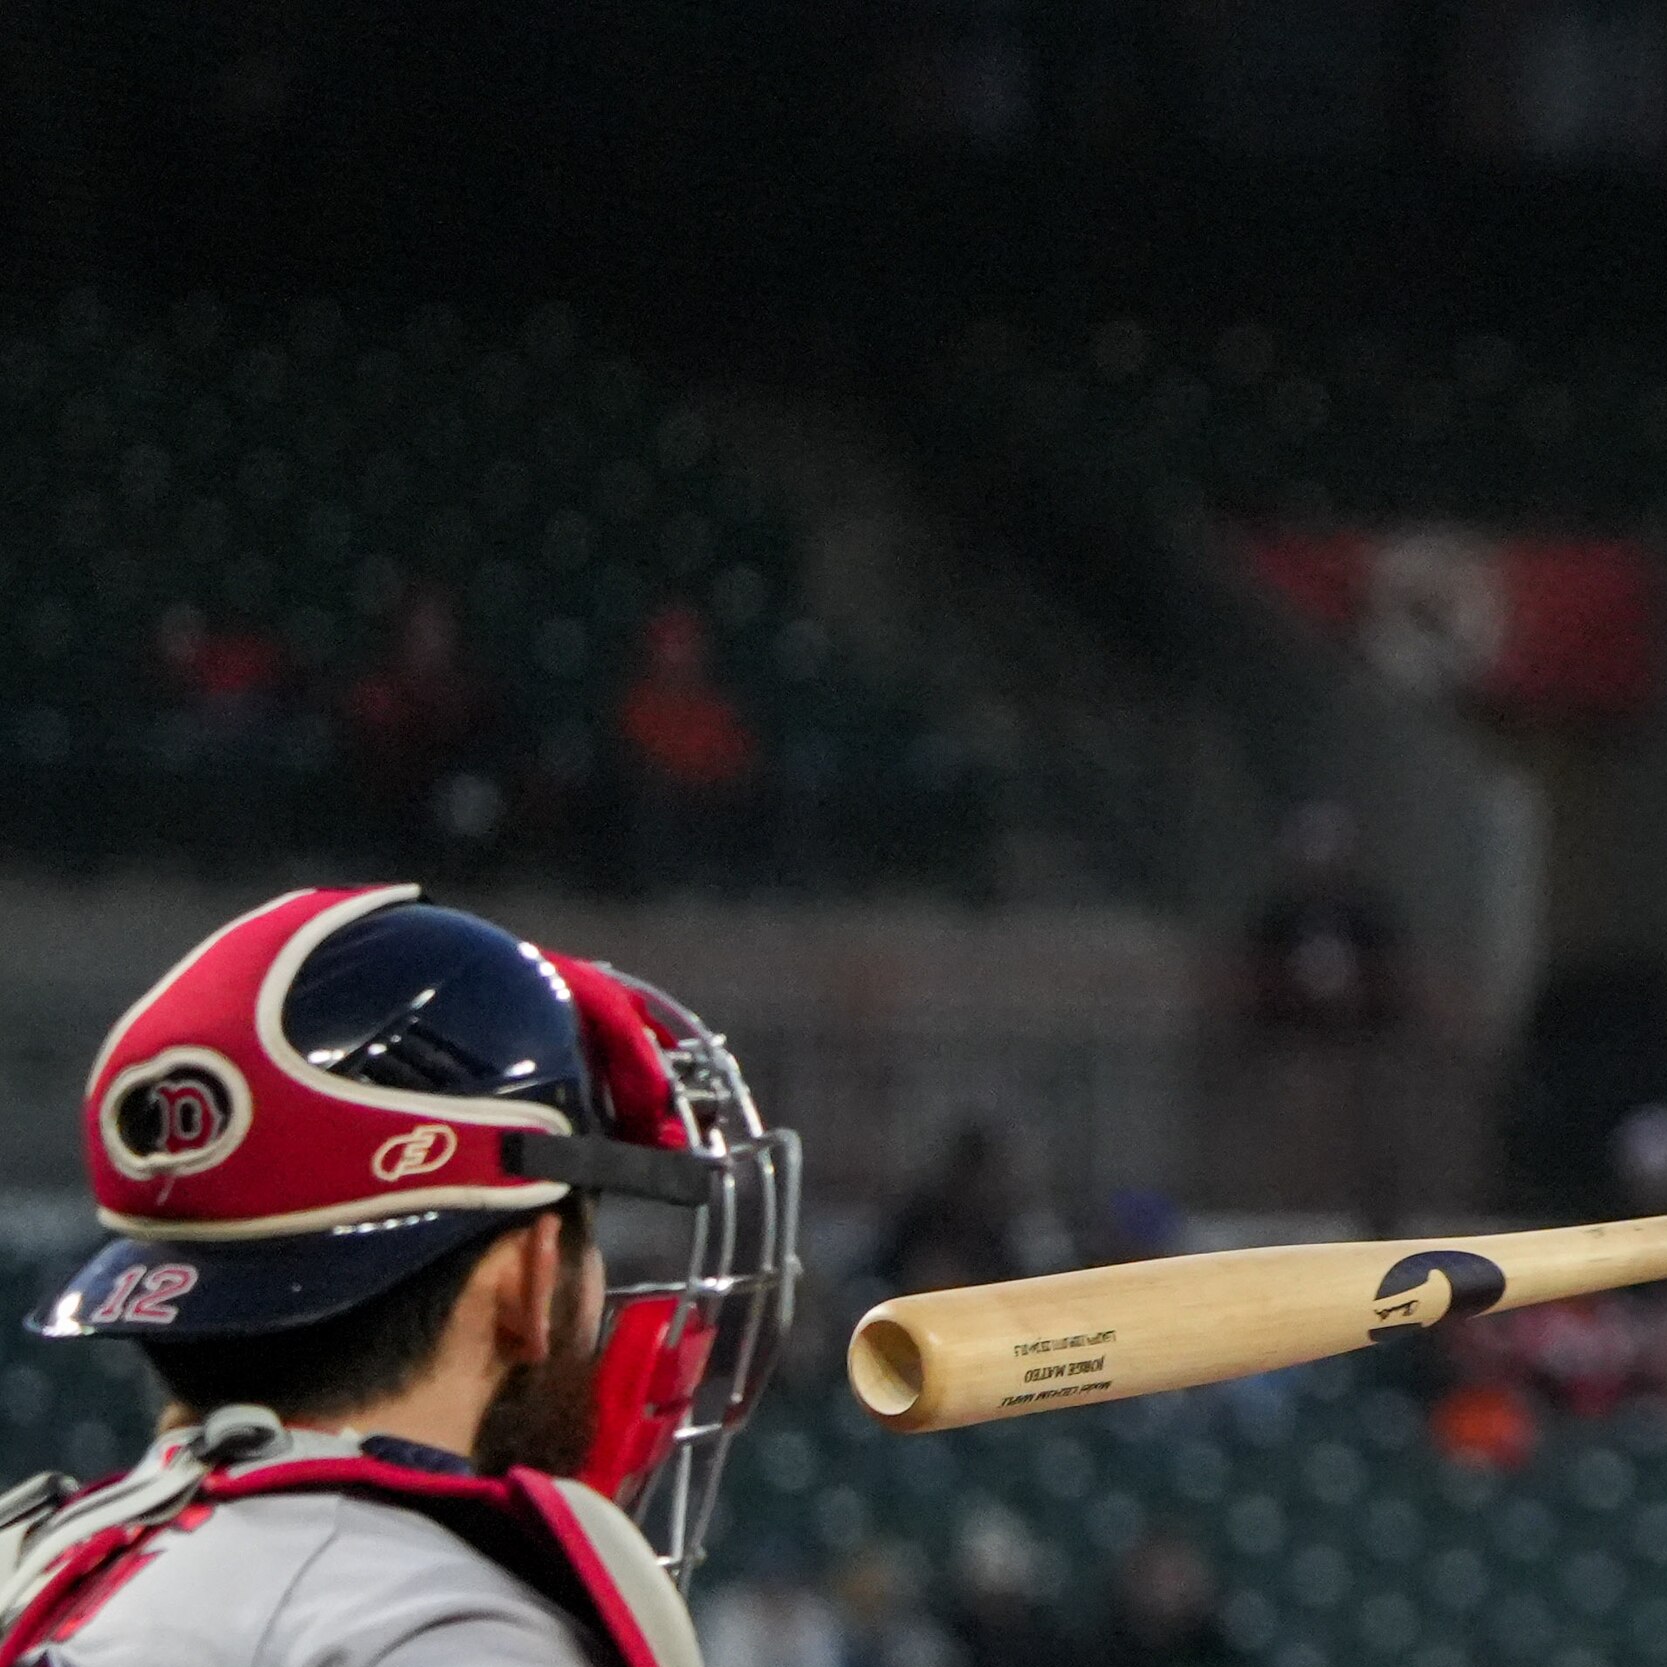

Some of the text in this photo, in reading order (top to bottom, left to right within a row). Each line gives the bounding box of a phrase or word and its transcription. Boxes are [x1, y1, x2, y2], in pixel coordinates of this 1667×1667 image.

[91, 1263, 198, 1324] 12
[1024, 1354, 1106, 1384] JORGE MATEO
